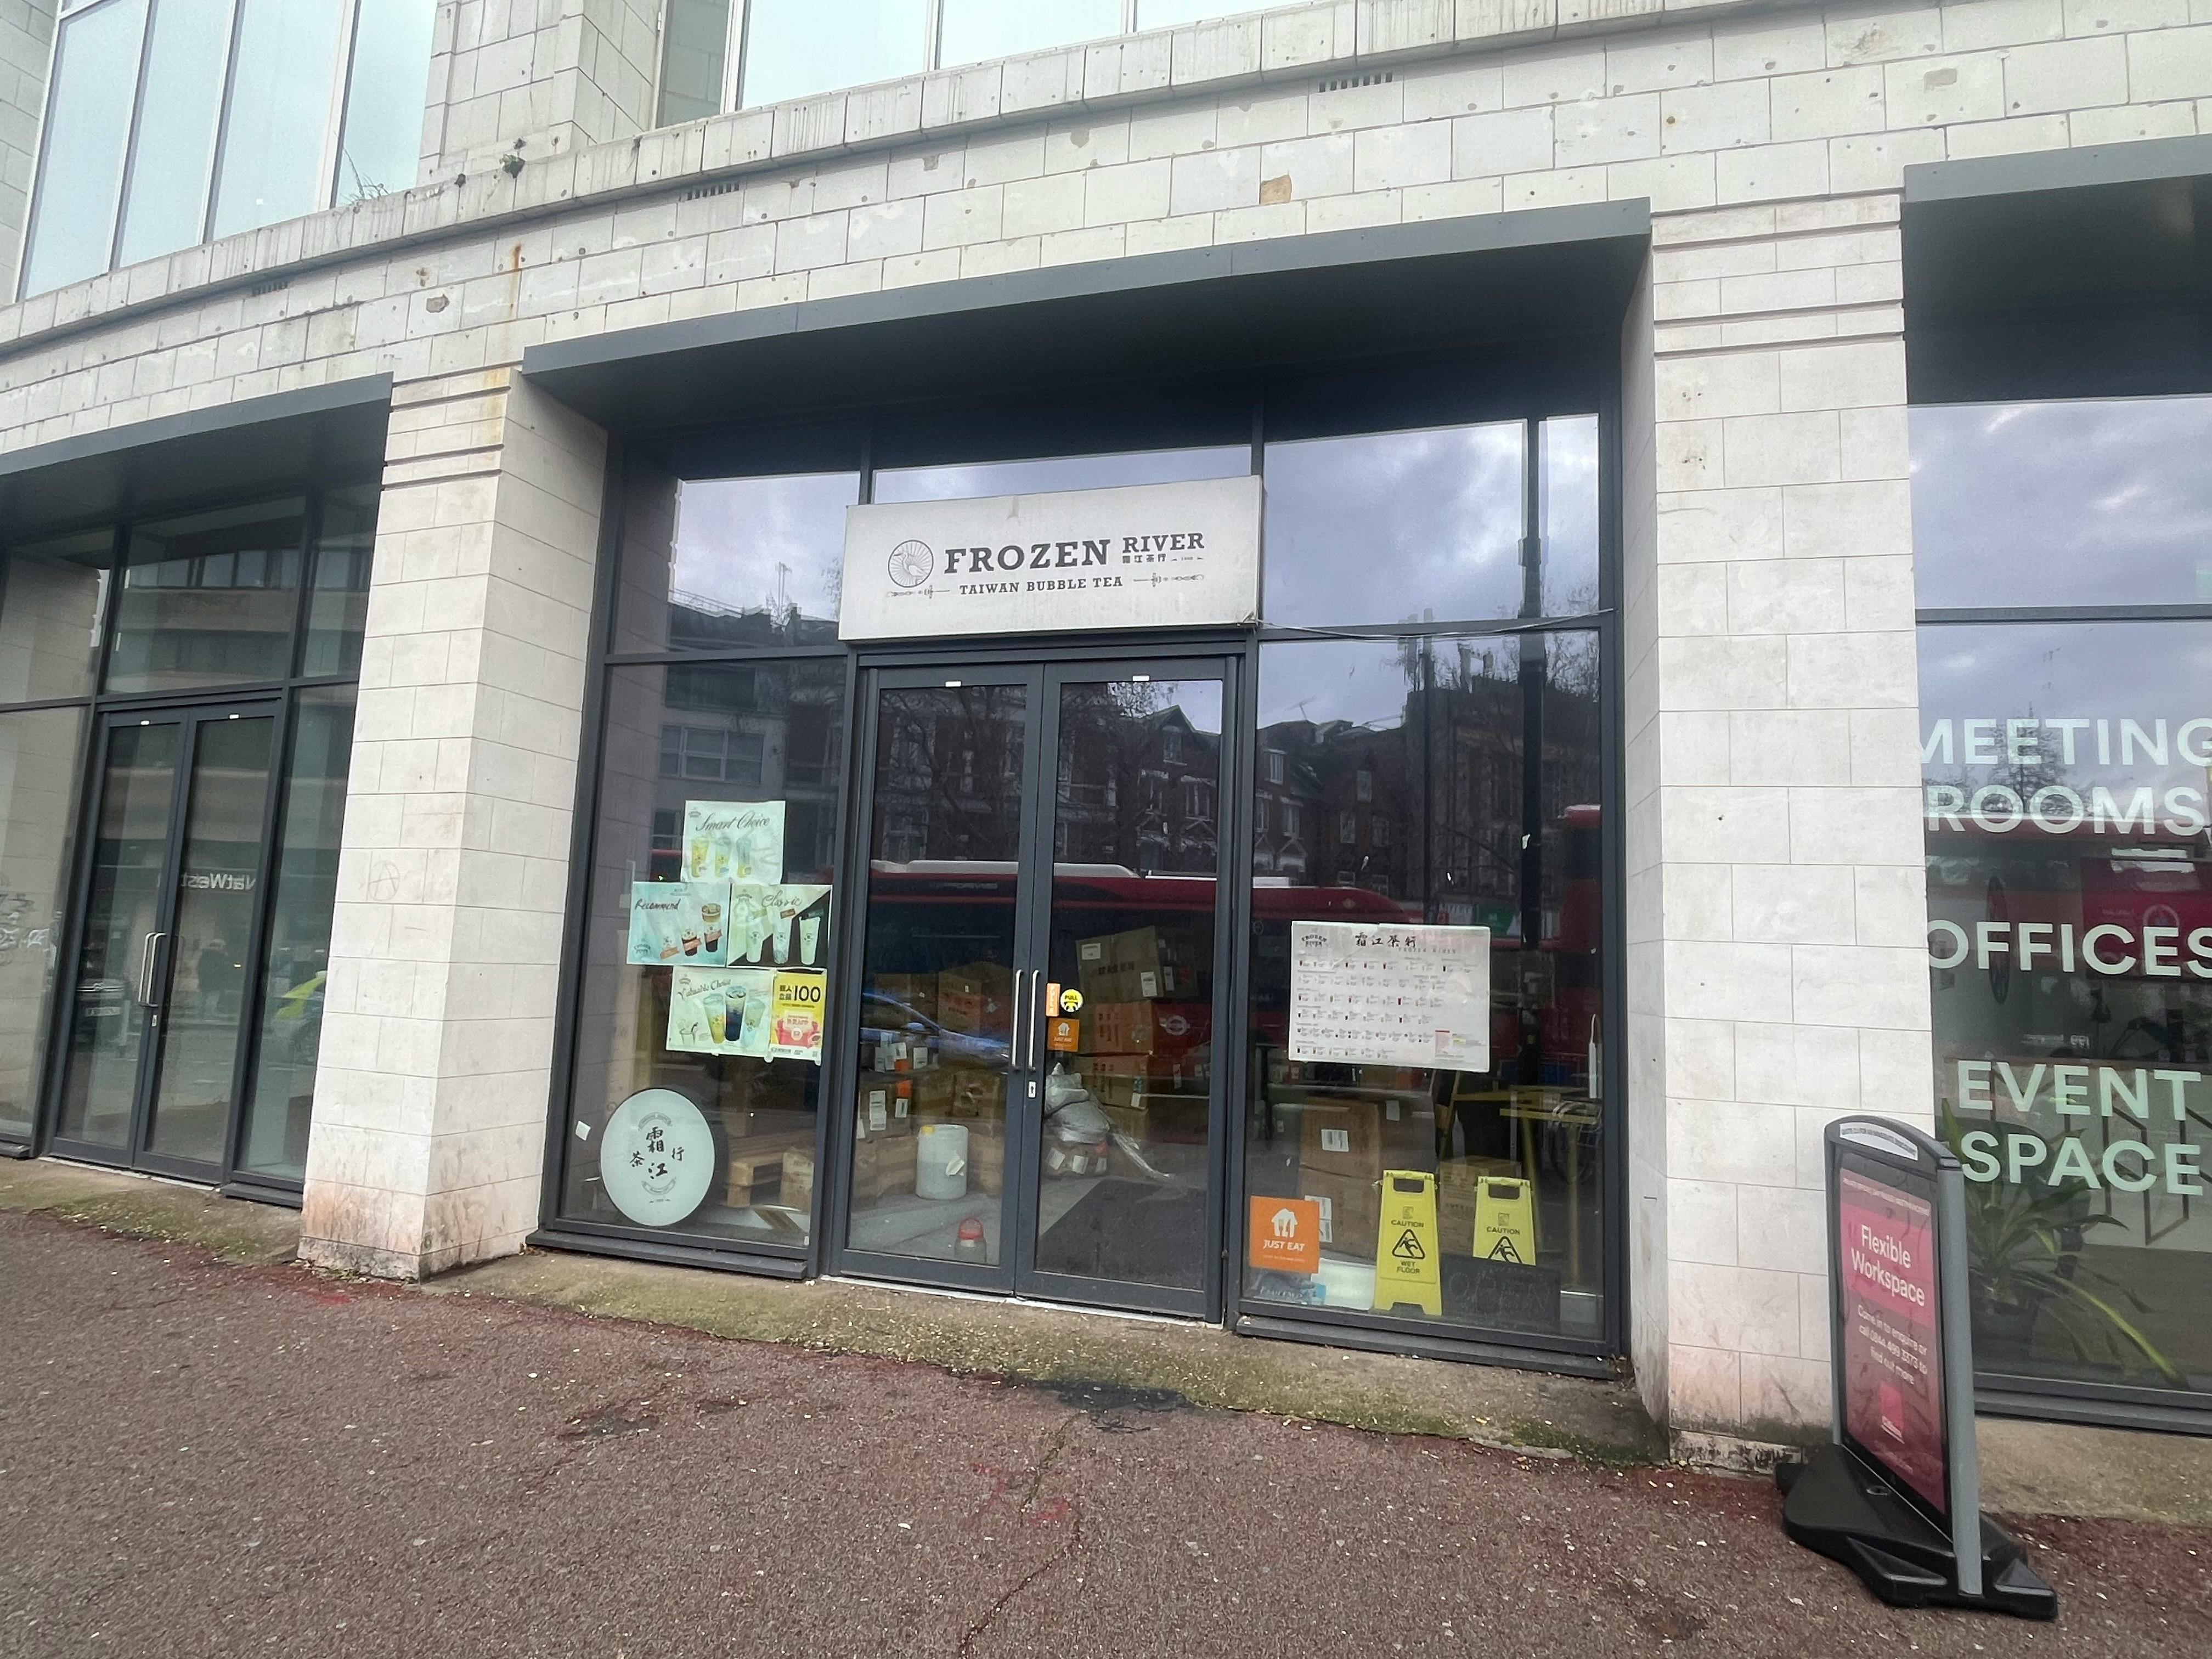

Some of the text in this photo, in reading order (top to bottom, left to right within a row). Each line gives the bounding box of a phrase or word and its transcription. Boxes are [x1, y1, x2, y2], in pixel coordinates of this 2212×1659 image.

[944, 532, 1205, 574] FROZEN RIVER
[960, 577, 1123, 595] TAIWAN BUBBLE TEA
[696, 812, 737, 831] Smart
[737, 810, 771, 829] Choice
[1927, 785, 2205, 836] ROOMS
[762, 890, 803, 907] Classic
[1928, 919, 2212, 978] OFFICES
[794, 985, 821, 1002] 100
[1957, 1059, 2202, 1121] EVENT
[1961, 1131, 2204, 1196] SPACE
[1391, 1220, 1424, 1228] CAUTION
[1486, 1226, 1521, 1235] CAUTION
[1263, 1239, 1306, 1251] JUST EAT
[1861, 1224, 1911, 1268] Flexible
[1851, 1248, 1925, 1306] Workspace
